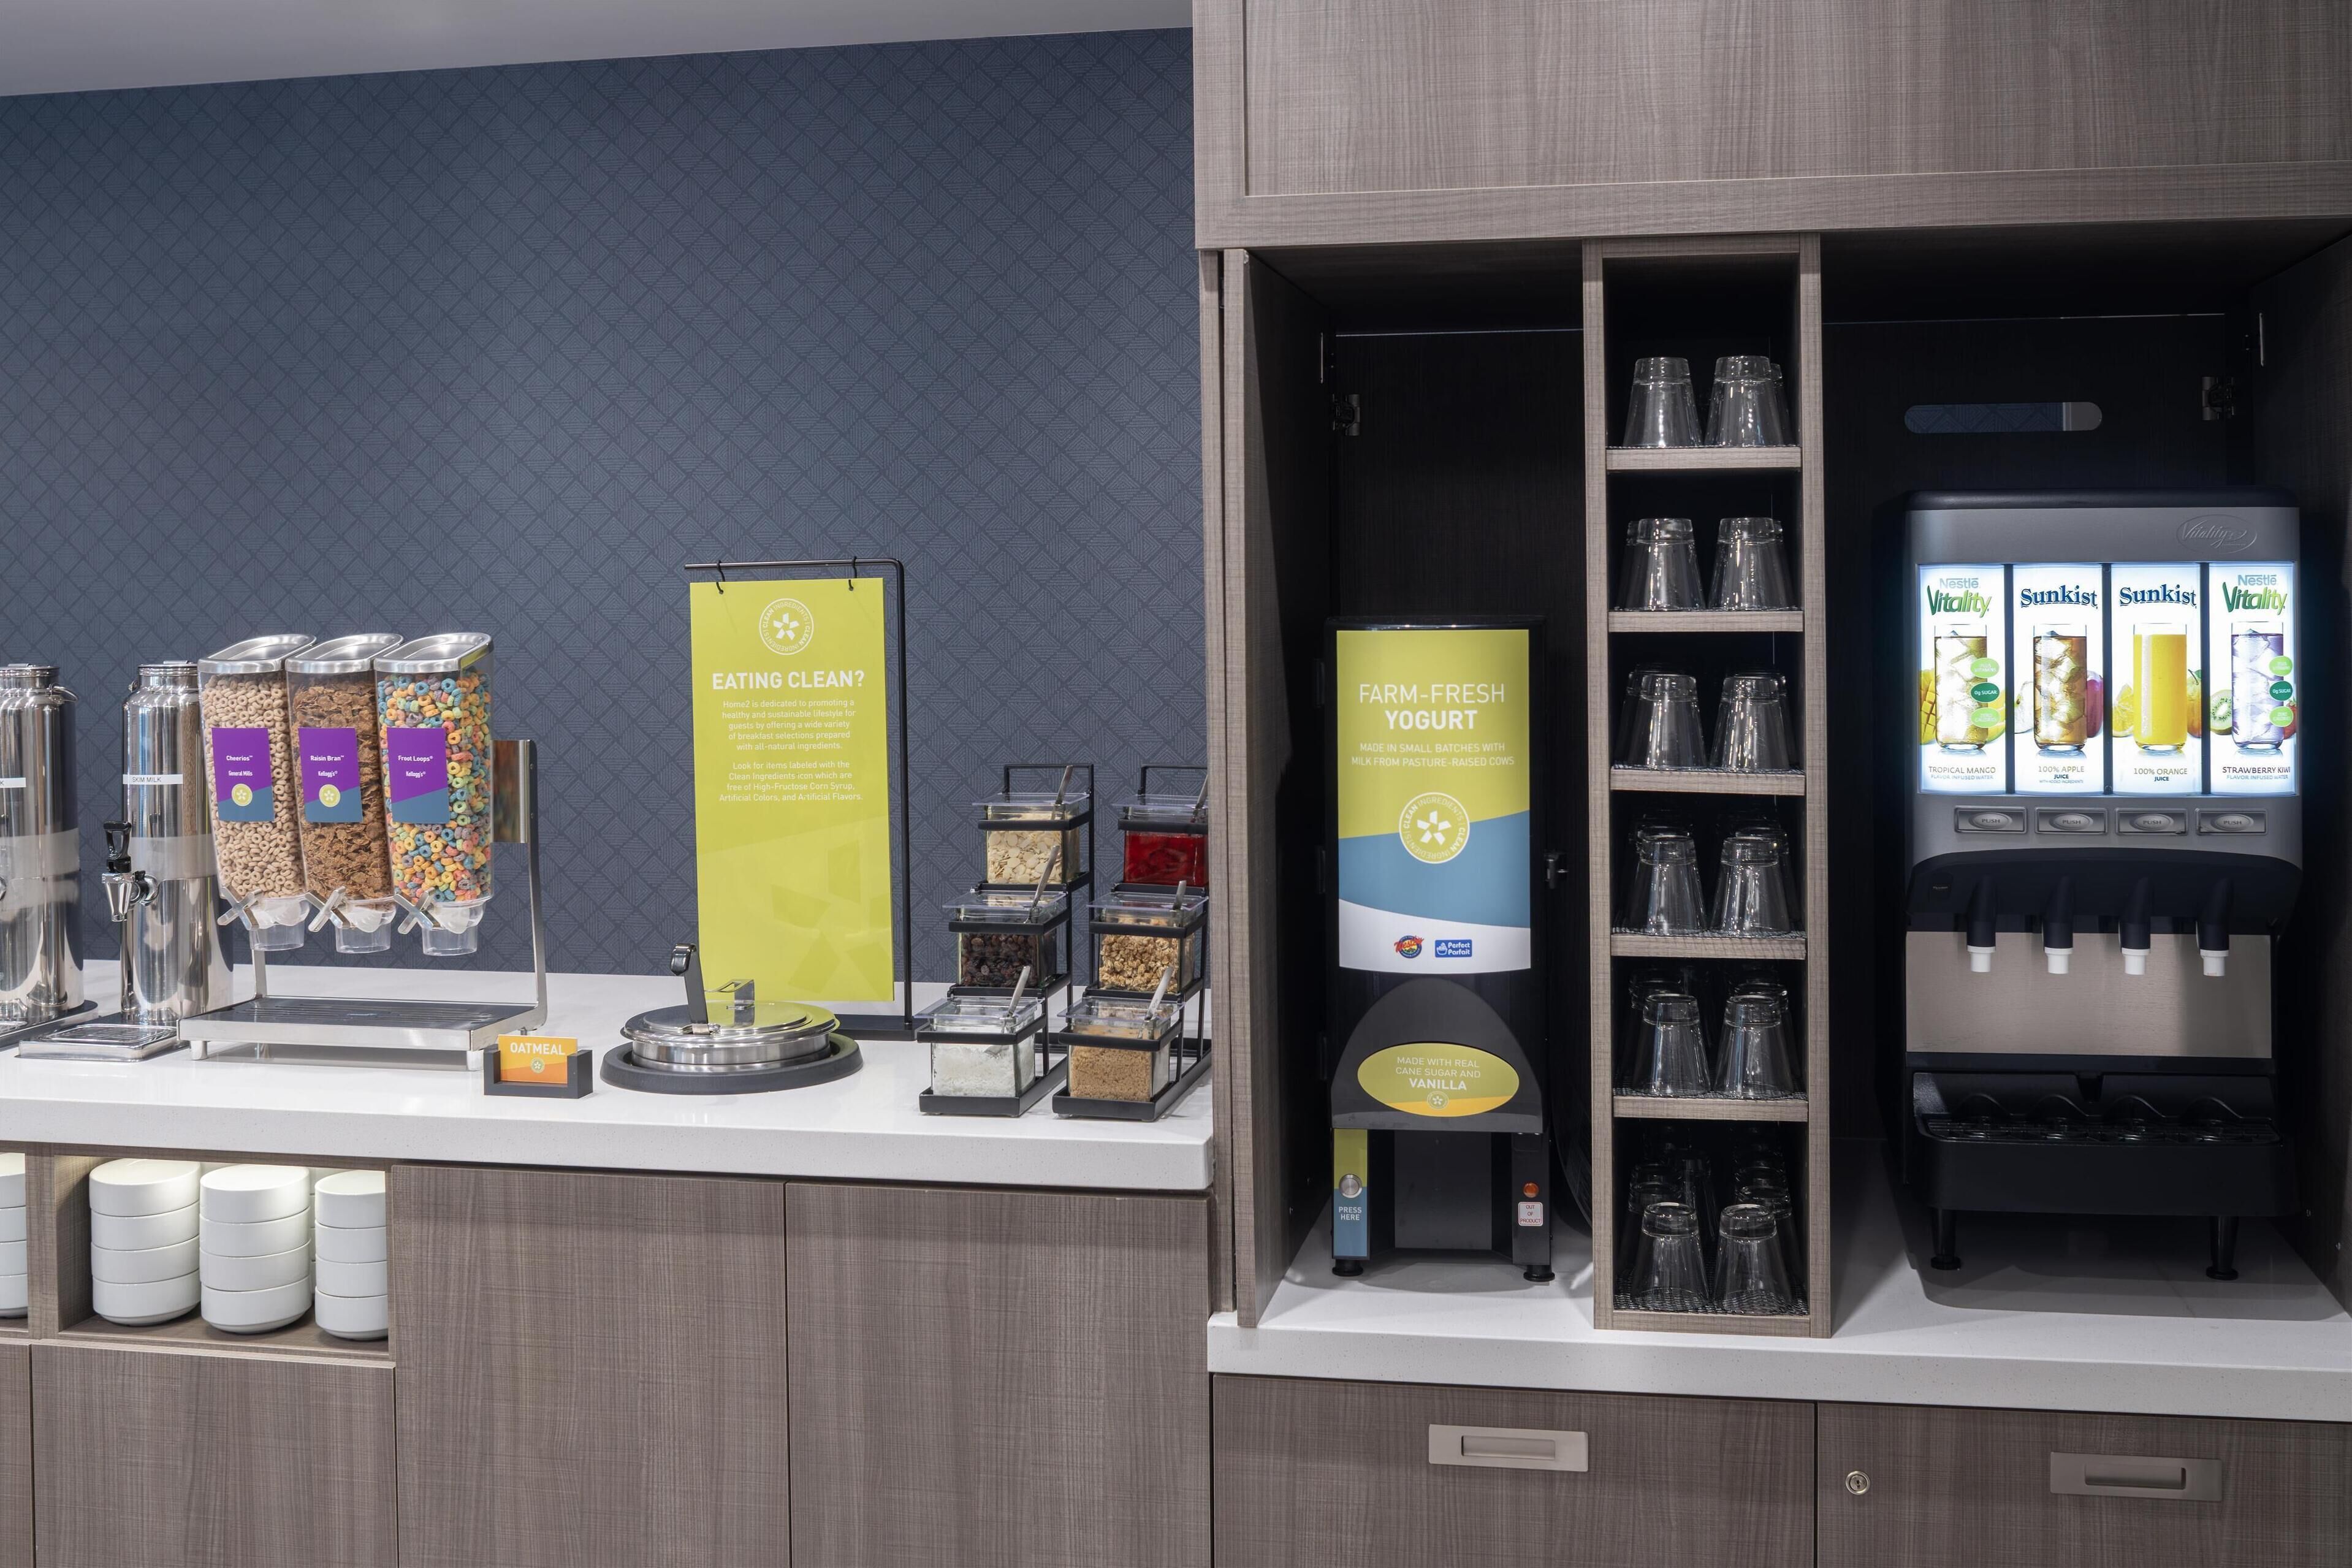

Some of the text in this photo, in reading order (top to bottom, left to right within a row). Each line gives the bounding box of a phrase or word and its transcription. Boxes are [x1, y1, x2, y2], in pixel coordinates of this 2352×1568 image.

[1927, 585, 1992, 618] Vitality
[2020, 585, 2097, 607] Sunkist
[2120, 584, 2196, 607] Sunkist
[2222, 582, 2288, 615] Vitality
[712, 670, 865, 690] EATING CLEAN?
[1360, 683, 1505, 704] FARM-FRESH
[809, 699, 847, 707] promoting
[813, 710, 843, 718] lifestyle
[1385, 710, 1478, 729] YOGURT
[816, 731, 850, 739] prepared
[1360, 742, 1505, 753] MADE IN SMALL BATCHES WITH
[1352, 756, 1515, 766] MILK FROM PASTURE-RAISED COWS
[753, 772, 796, 782] Ingredients
[754, 783, 808, 792] High-Fructose
[831, 782, 854, 791] Syrup,
[1403, 797, 1464, 829] CLEAN INGREDIENTS
[1450, 828, 1466, 852] CLEAN
[510, 1042, 566, 1055] OATMEAL
[1455, 1059, 1480, 1068] REAL
[1425, 1068, 1457, 1077] SUGAR
[1460, 1070, 1480, 1078] AND
[1409, 1078, 1467, 1090] VANILLA
